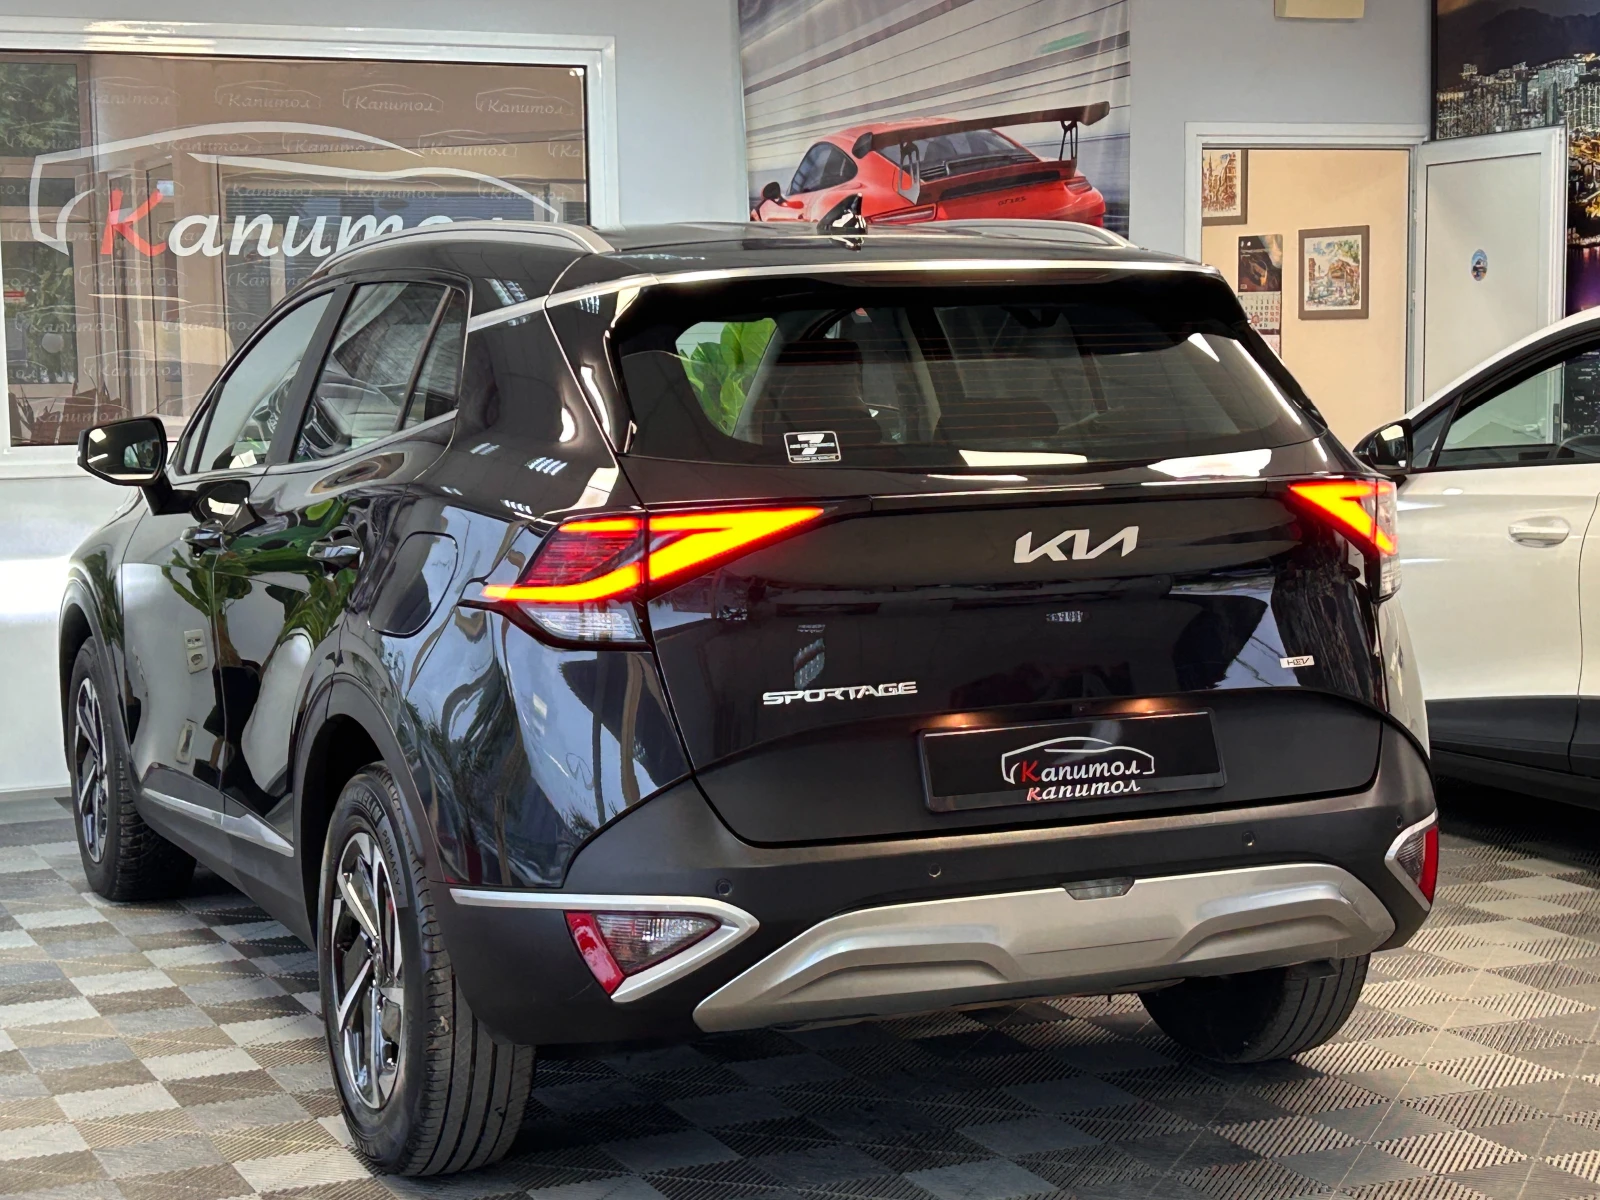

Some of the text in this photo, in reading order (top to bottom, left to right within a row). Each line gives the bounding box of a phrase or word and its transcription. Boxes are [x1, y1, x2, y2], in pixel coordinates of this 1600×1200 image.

[229, 93, 311, 108] Капитол
[354, 95, 434, 112] Капитол
[487, 98, 564, 114] Капитол
[429, 141, 508, 157] Капитол
[1013, 525, 1139, 564] KIA
[763, 681, 918, 705] SPORTAGE
[1020, 759, 1141, 783] Капитол
